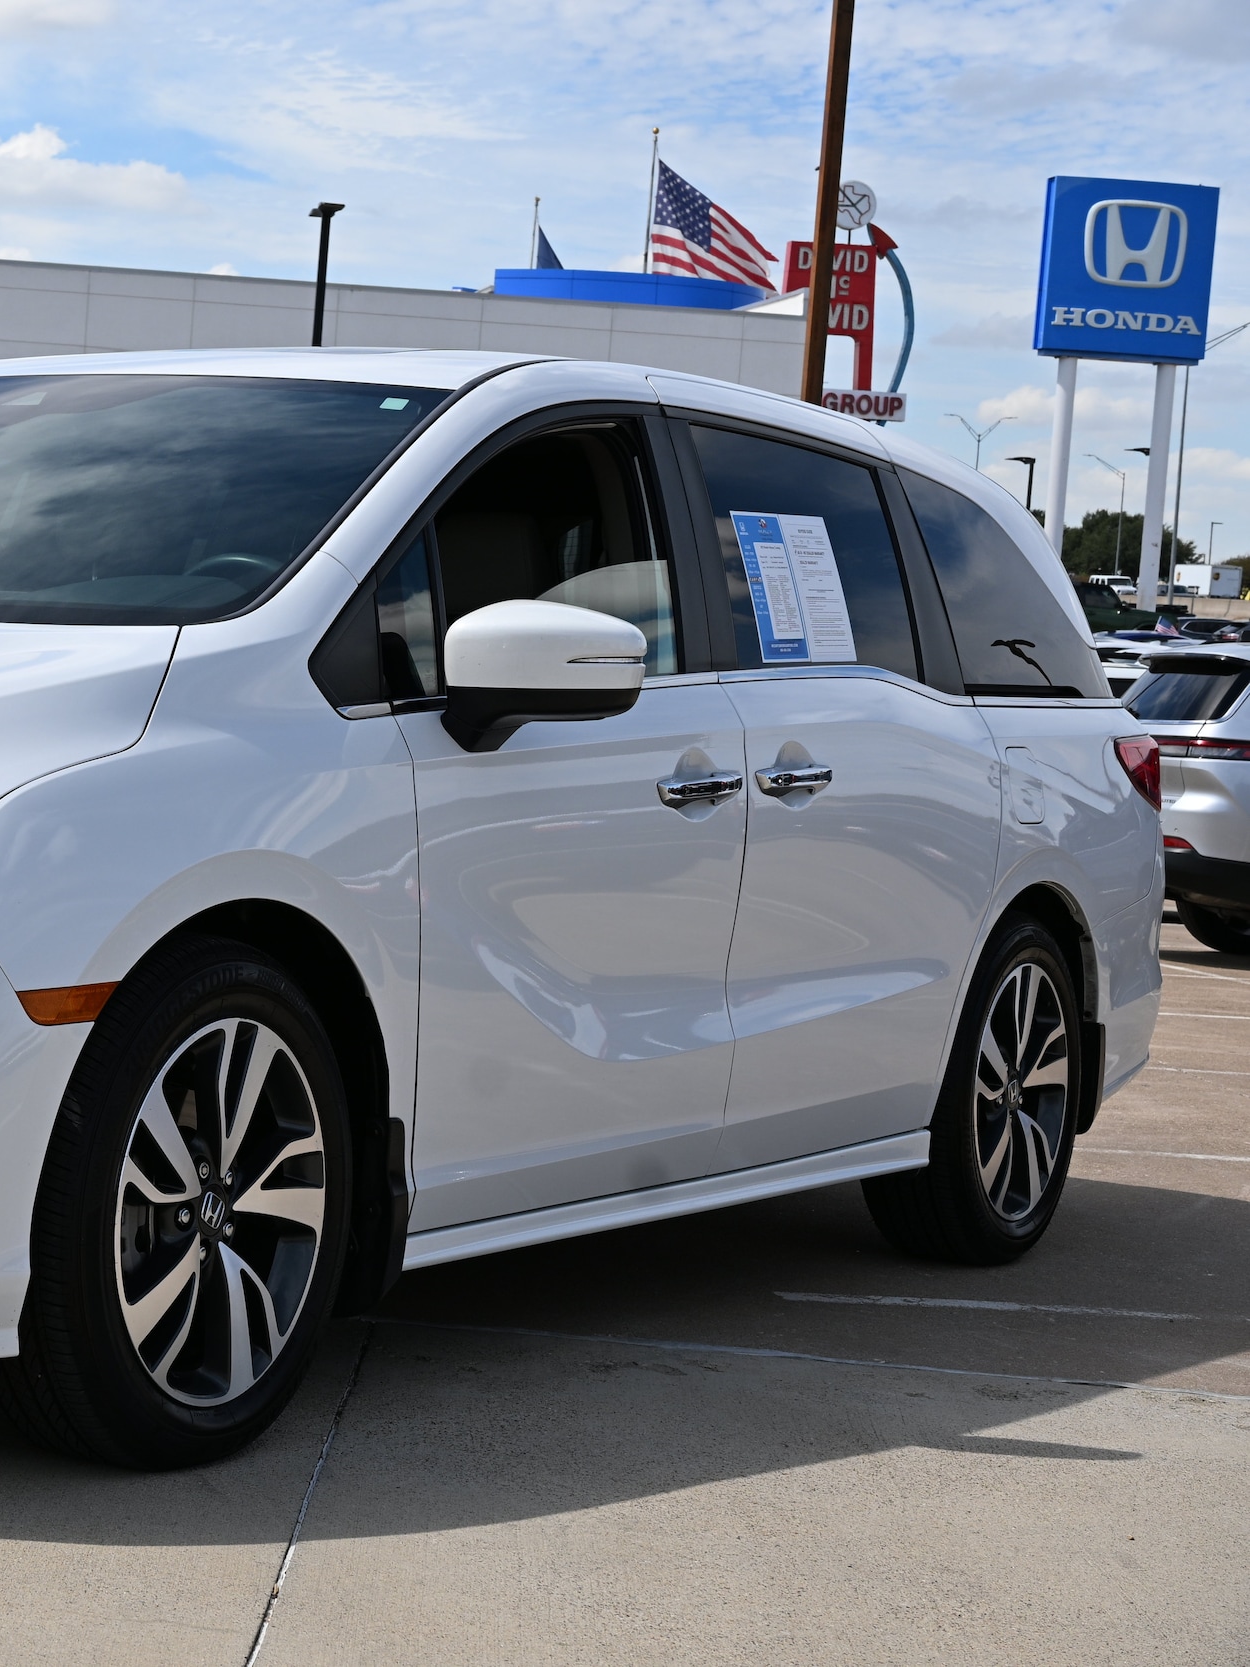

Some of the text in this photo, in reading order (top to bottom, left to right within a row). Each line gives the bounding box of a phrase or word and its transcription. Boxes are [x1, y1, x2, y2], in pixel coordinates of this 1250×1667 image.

[798, 246, 869, 273] DVID
[828, 302, 869, 331] VID
[1051, 306, 1201, 335] HONDA
[822, 392, 903, 417] GROUP
